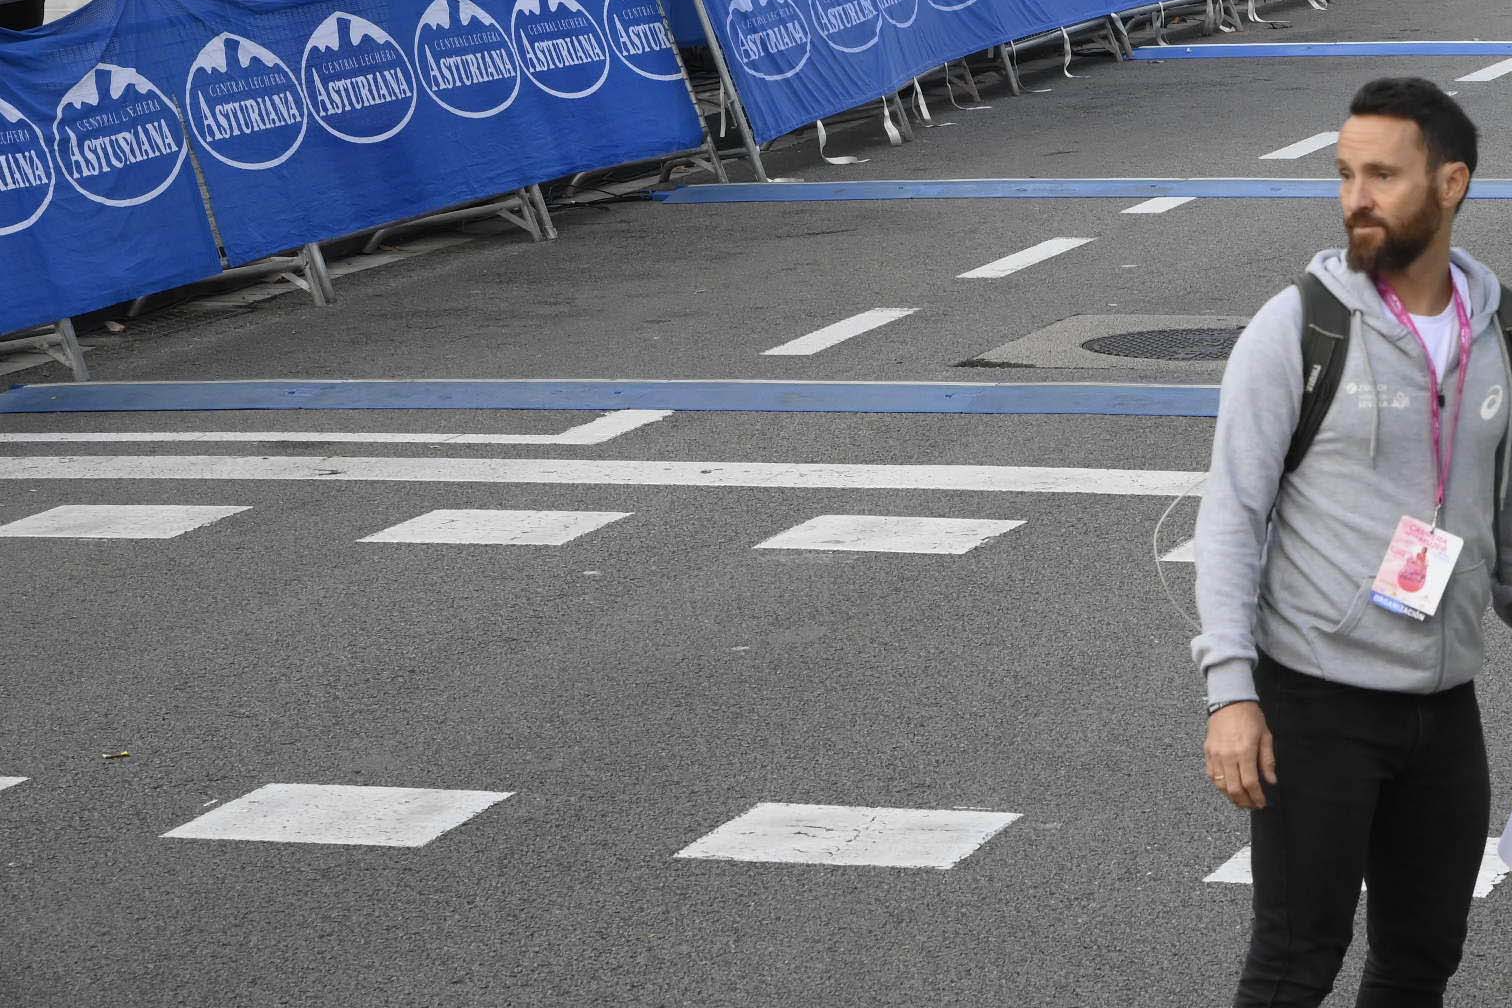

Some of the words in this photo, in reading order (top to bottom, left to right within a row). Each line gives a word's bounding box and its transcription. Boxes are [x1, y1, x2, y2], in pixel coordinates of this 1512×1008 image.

[434, 36, 467, 51] CENTRAL
[467, 30, 501, 45] LECHERA
[528, 21, 557, 34] CENTRAL
[557, 16, 589, 30] LECHERA
[613, 13, 673, 57] ASTUR
[322, 59, 358, 75] CENTRAL
[359, 50, 397, 69] LECHERA
[424, 43, 517, 92] ASTURIANA
[519, 27, 605, 73] ASTURIANA
[209, 81, 248, 98] CENTRAL
[250, 72, 286, 91] LECHERA
[312, 66, 413, 117] ASTURIANA
[76, 112, 118, 133] CENTRAL
[198, 90, 302, 143] ASTURIANA
